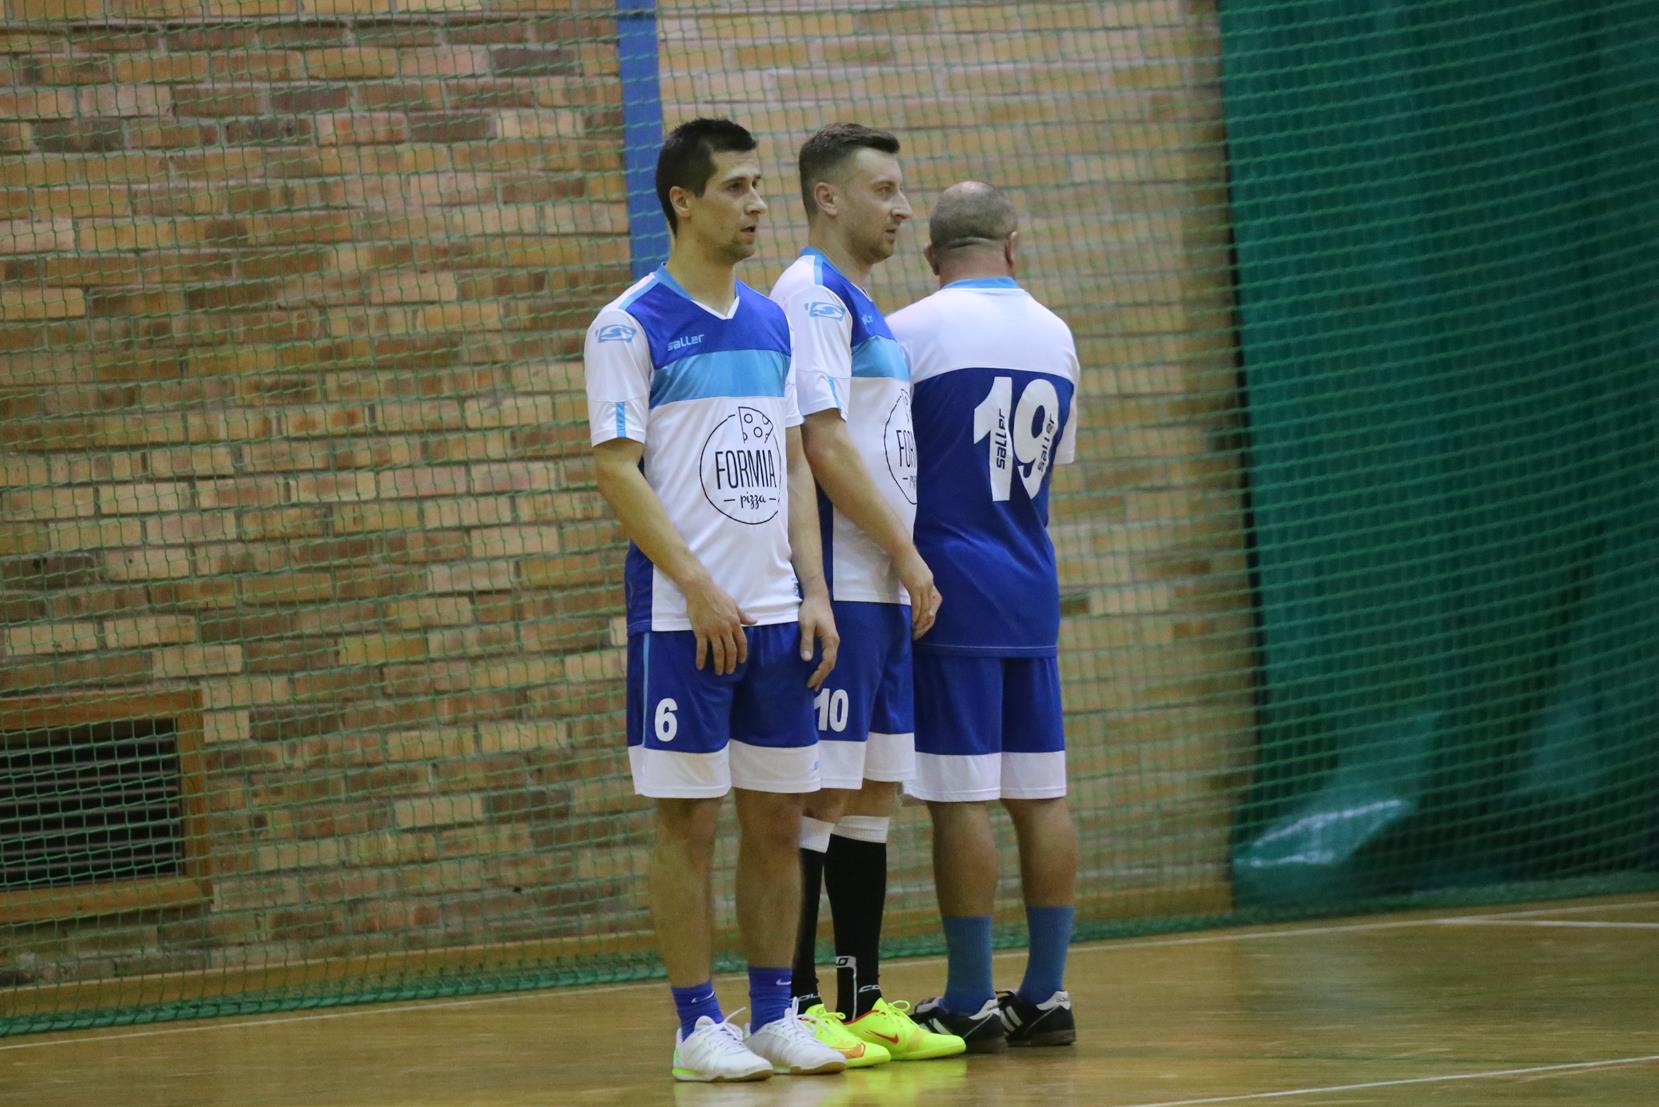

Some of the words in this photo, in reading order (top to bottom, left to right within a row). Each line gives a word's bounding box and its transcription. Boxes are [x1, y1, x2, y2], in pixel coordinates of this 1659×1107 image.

[667, 334, 705, 351] saller
[973, 376, 1059, 501] 19
[995, 407, 1007, 470] saller
[1037, 412, 1055, 472] saller
[715, 449, 777, 490] FORMIA
[740, 491, 766, 510] pizza
[654, 697, 678, 742] 6
[813, 687, 849, 732] 10
